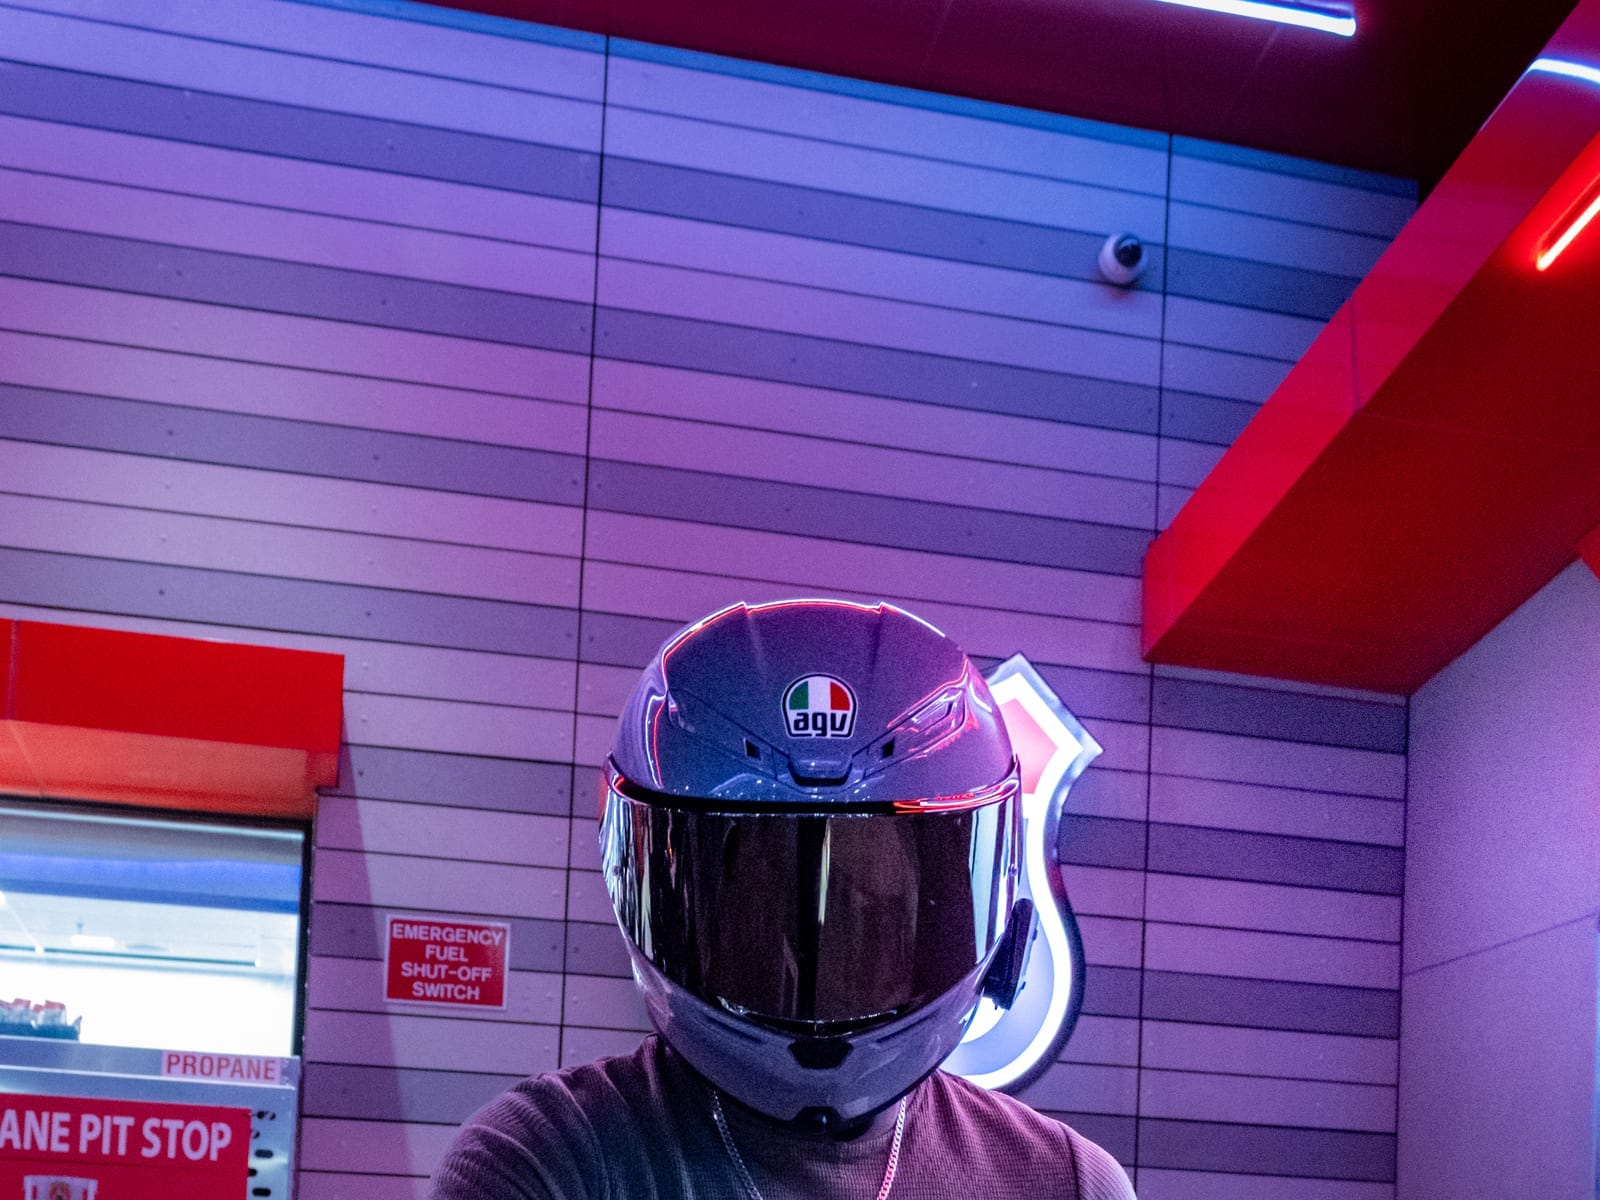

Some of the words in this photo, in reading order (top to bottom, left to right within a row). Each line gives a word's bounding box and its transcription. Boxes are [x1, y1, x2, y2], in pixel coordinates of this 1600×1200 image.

[793, 712, 848, 737] agv
[392, 923, 503, 945] EMERGENCY
[425, 944, 468, 962] FUEL
[402, 961, 492, 982] SHUT-OFF
[413, 981, 479, 1001] SWITCH
[166, 1054, 276, 1081] PROPANE
[80, 1114, 134, 1155] PIT
[141, 1118, 231, 1161] STOP
